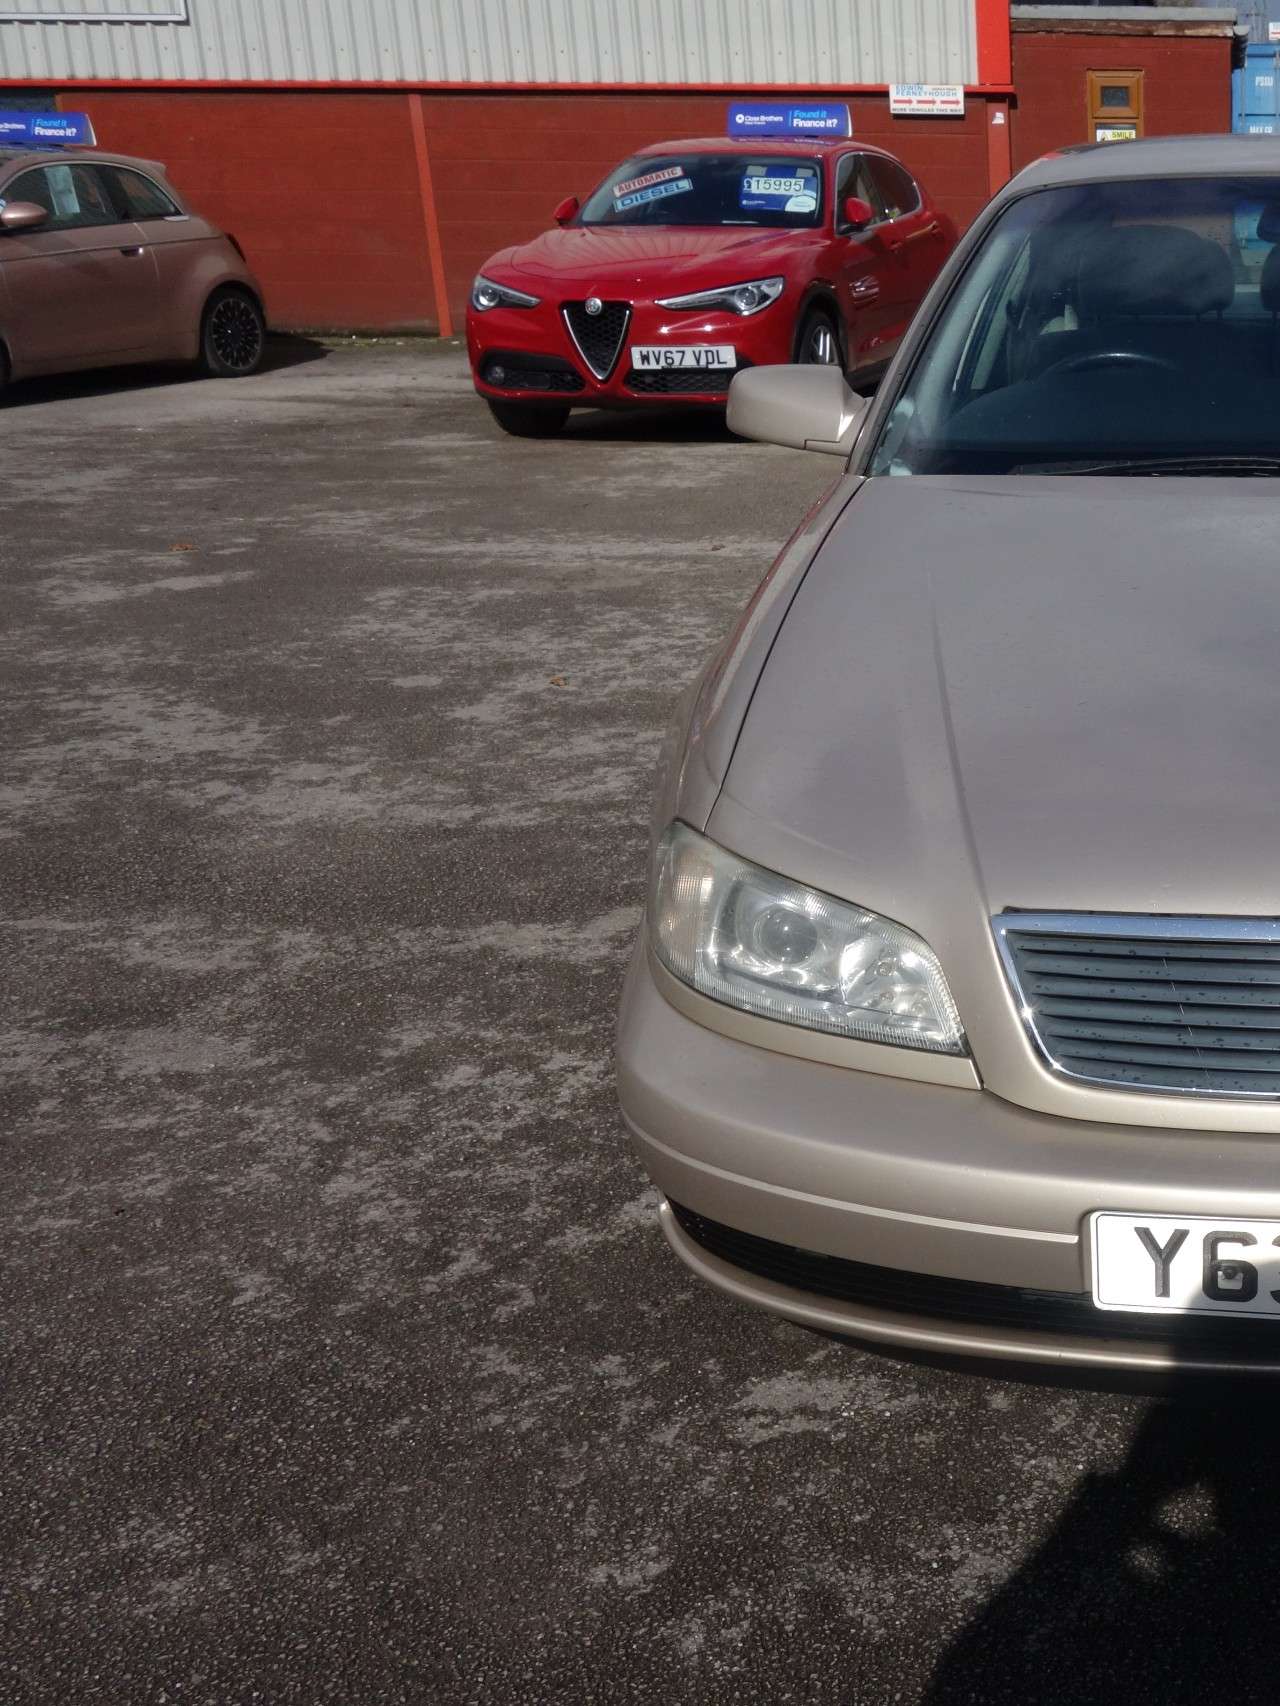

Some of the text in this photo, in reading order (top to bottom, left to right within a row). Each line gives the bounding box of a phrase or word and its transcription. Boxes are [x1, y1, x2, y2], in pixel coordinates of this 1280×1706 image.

[794, 110, 827, 118] Found it
[793, 119, 838, 127] Finance it?
[35, 127, 77, 136] Finance it?
[618, 168, 678, 193] AUTOMATIC
[621, 183, 686, 207] DIESEL
[640, 350, 685, 366] WV67
